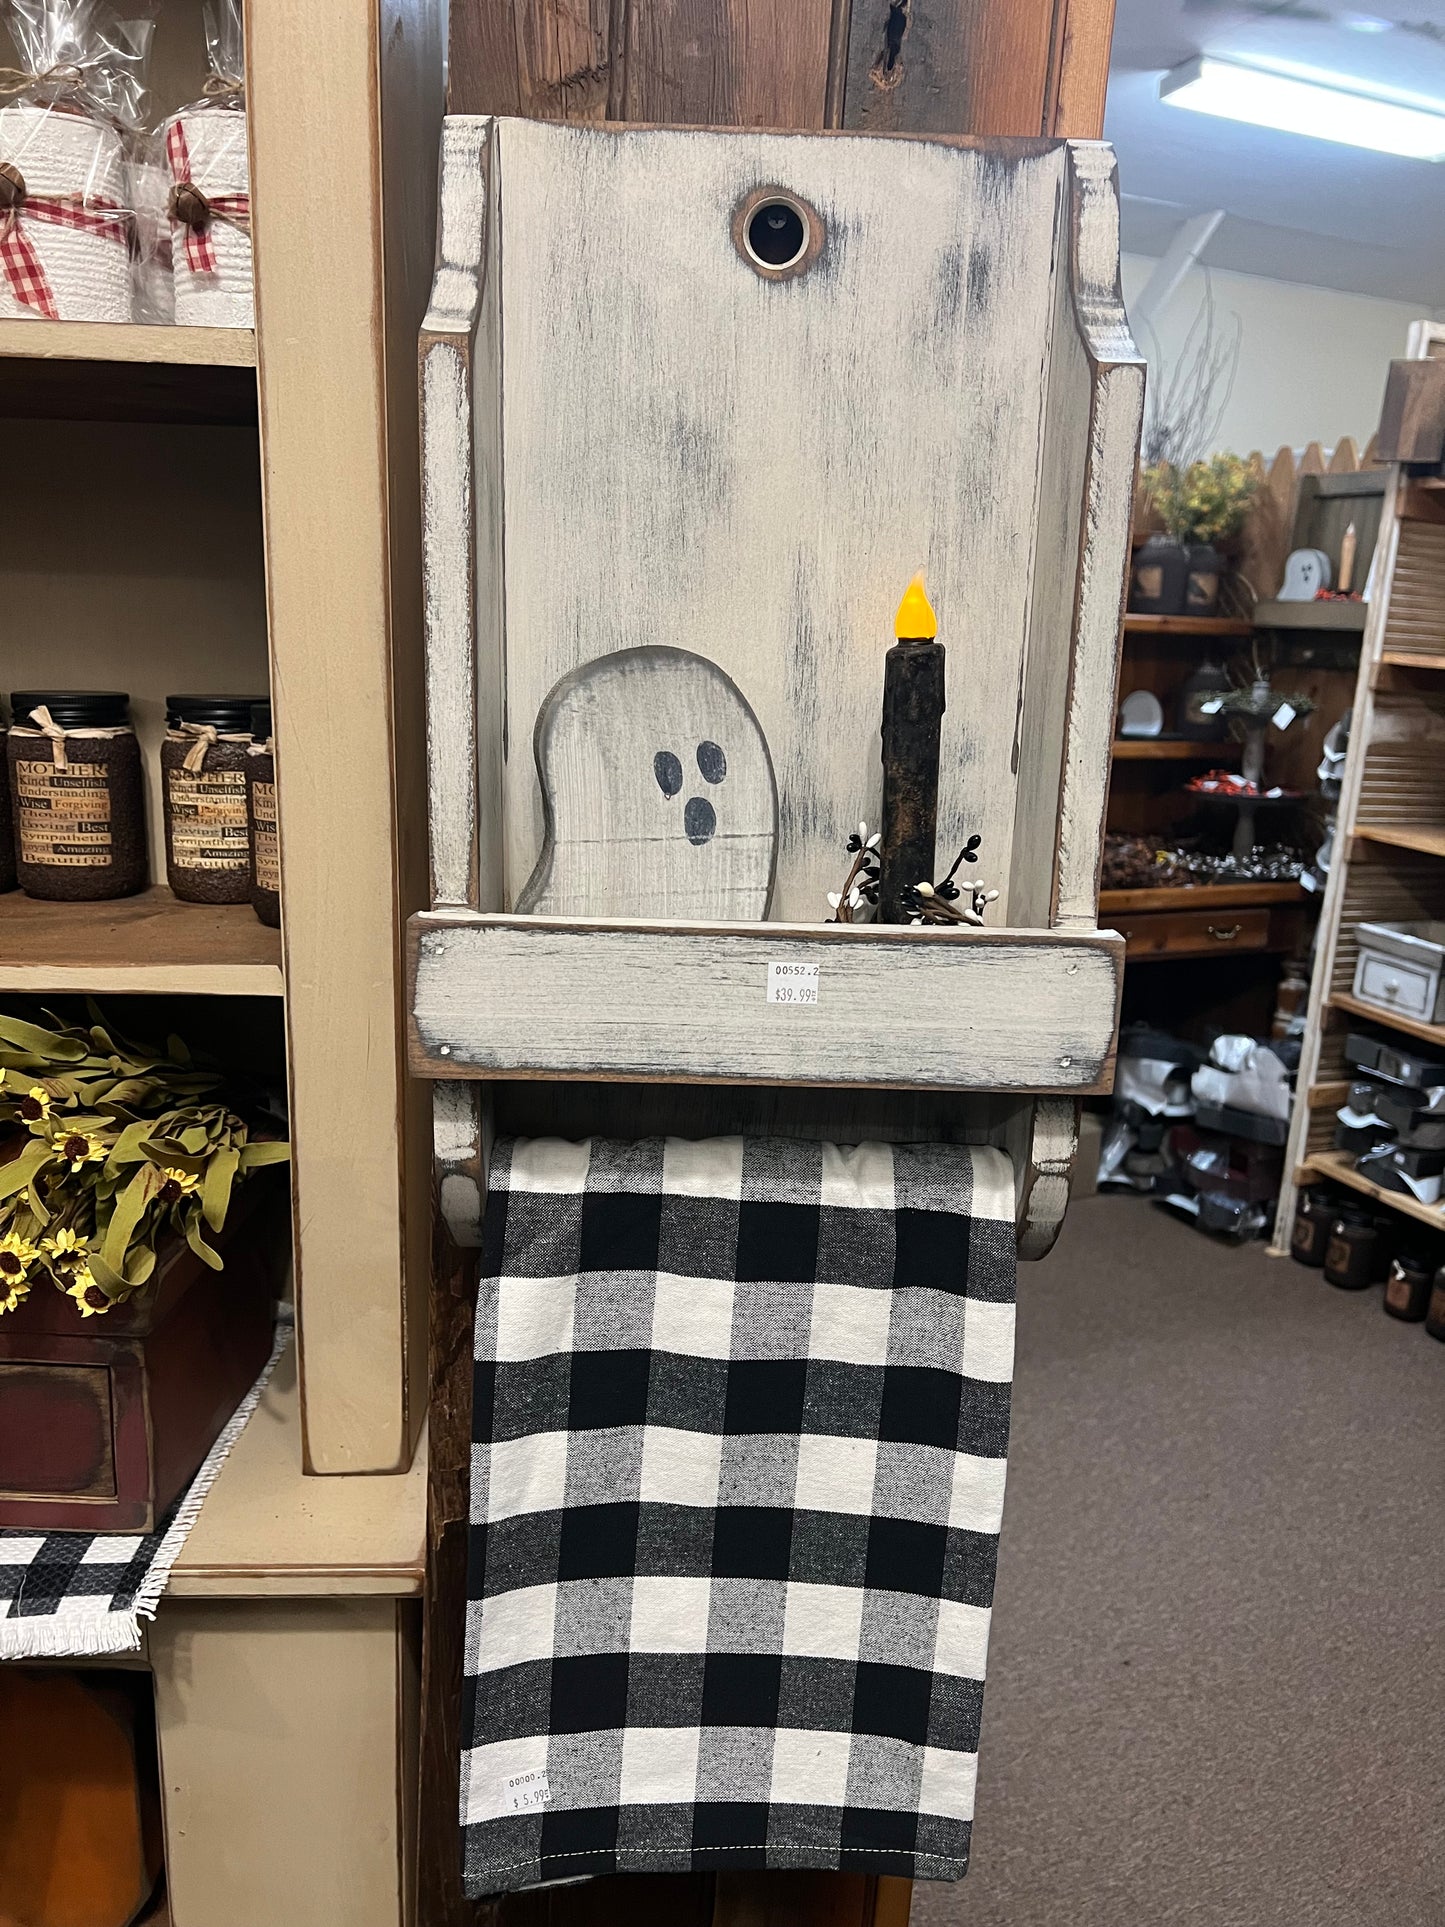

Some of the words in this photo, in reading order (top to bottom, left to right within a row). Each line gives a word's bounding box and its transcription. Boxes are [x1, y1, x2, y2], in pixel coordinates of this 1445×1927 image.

[20, 776, 46, 787] Kind
[53, 777, 106, 788] Unselfish
[20, 786, 106, 798] Understanding
[201, 784, 247, 794] Unselfish
[21, 797, 48, 809] Wise
[55, 799, 108, 810] Forgiving
[255, 797, 276, 808] Kin
[22, 809, 108, 820] Thoughtful
[172, 804, 195, 815] Wise
[22, 820, 76, 832] Loving
[81, 822, 108, 832] Best
[22, 831, 108, 843] Sympathetic
[57, 845, 109, 854] Amazing
[25, 853, 108, 864] Beautiful
[775, 965, 819, 976] 00552.2
[775, 987, 811, 1002] $39.99
[509, 1770, 546, 1788] 00000.2
